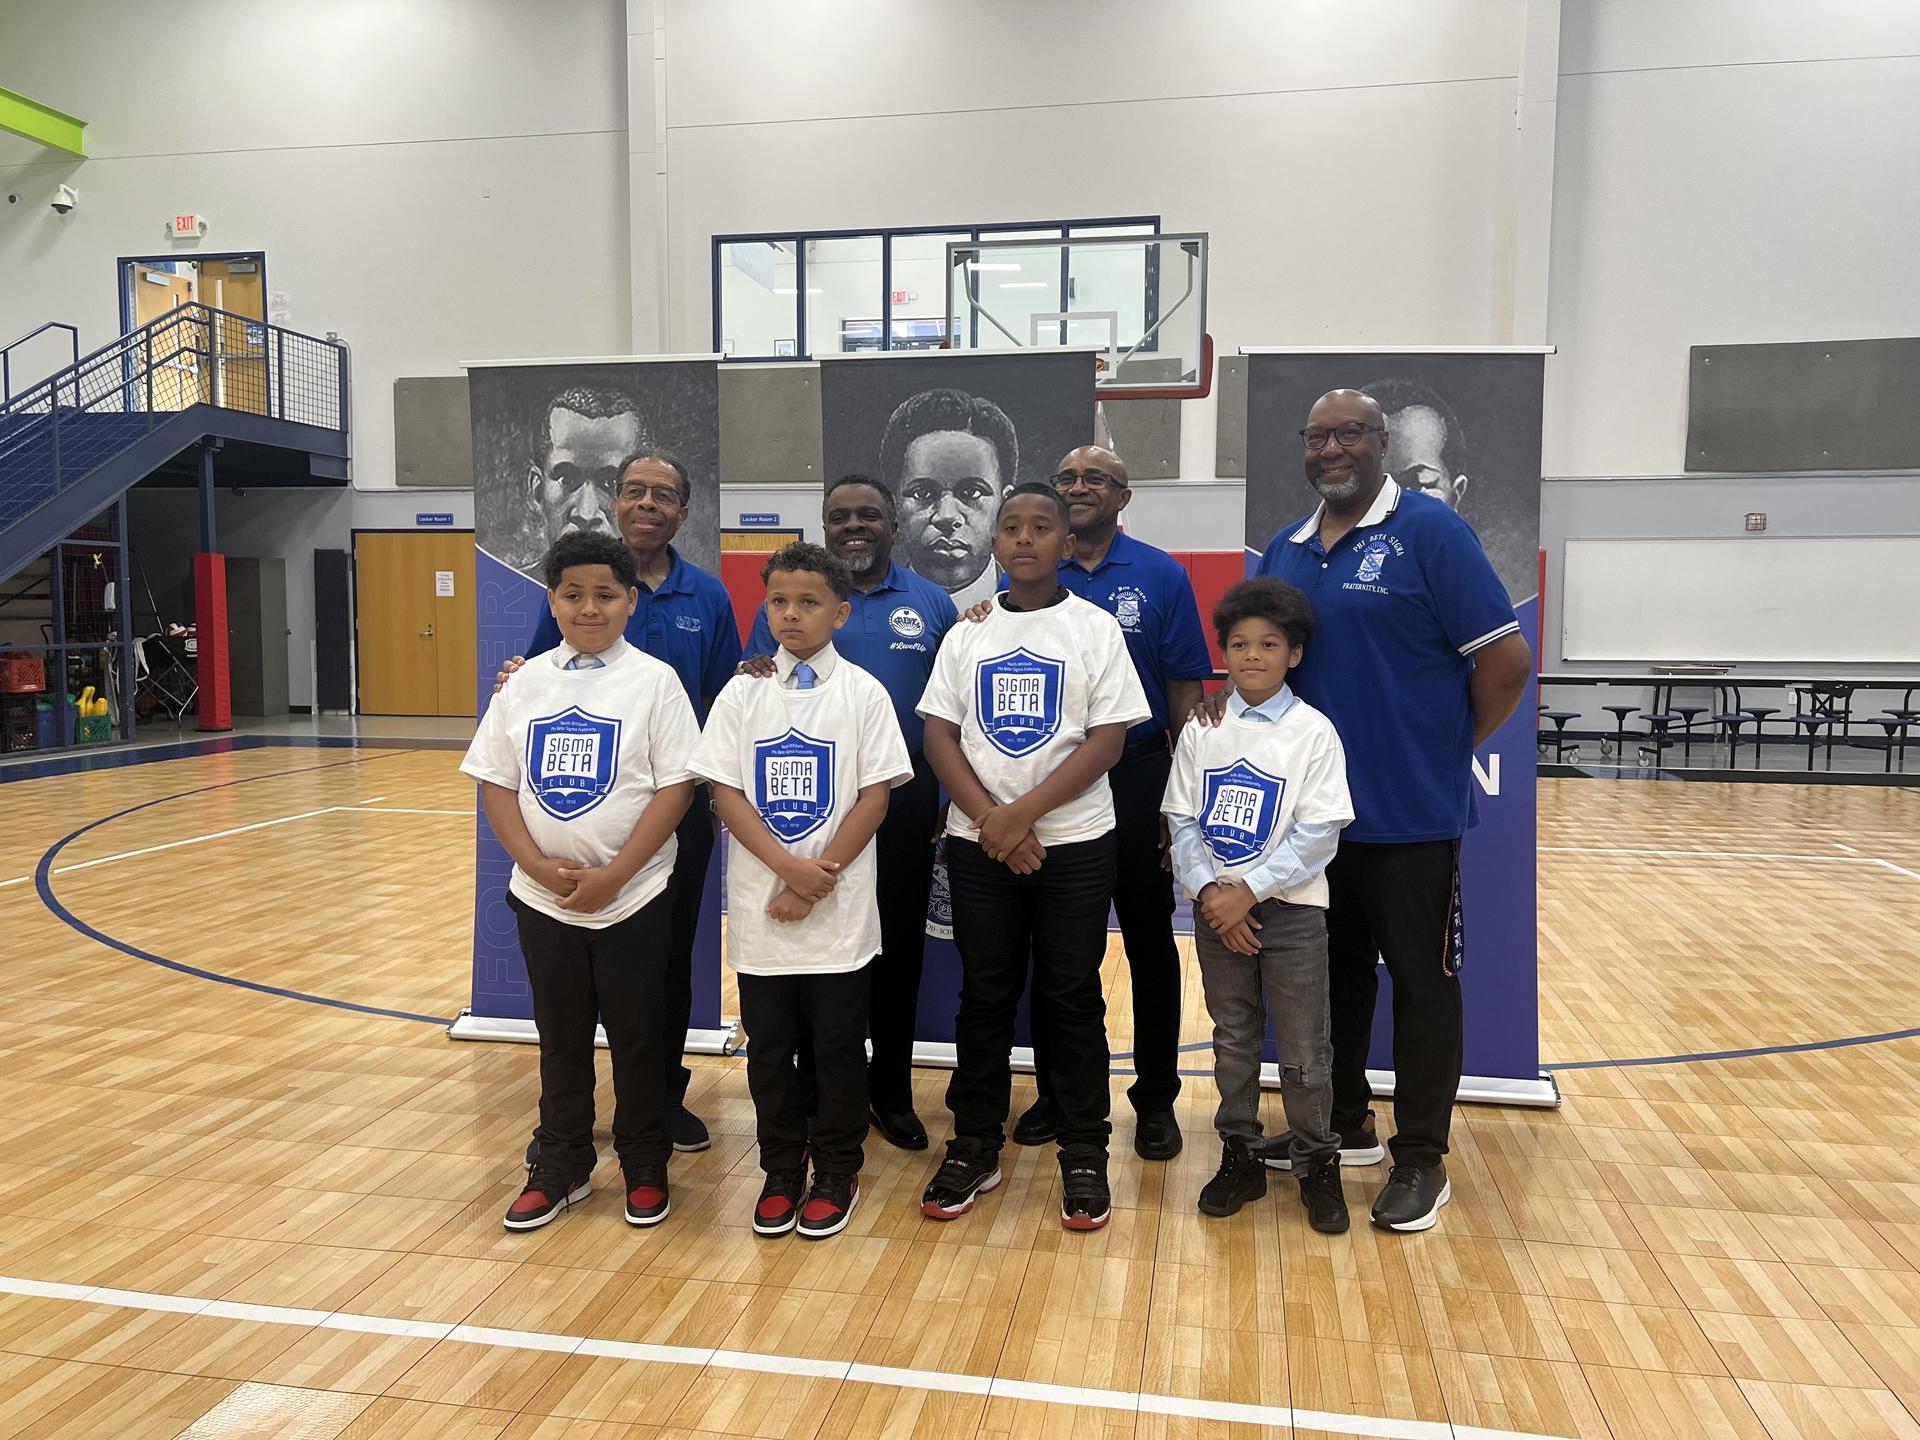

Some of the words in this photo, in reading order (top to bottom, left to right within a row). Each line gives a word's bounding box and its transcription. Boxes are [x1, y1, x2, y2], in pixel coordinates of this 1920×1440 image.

[176, 216, 194, 231] EXIT
[1352, 540, 1366, 552] PHI
[1369, 533, 1387, 542] BETA
[1388, 536, 1405, 557] SIGMA
[998, 678, 1039, 692] SIGMA
[998, 693, 1039, 711] BETA
[1001, 717, 1034, 726] CLUB
[549, 738, 594, 753] SIGMA
[547, 753, 592, 772] BETA
[770, 761, 812, 776] SIGMA
[549, 778, 586, 788] CLUB
[771, 777, 812, 796] BETA
[1219, 789, 1258, 808] SIGMA
[1212, 804, 1254, 827] BETA
[1212, 827, 1245, 840] CLUB
